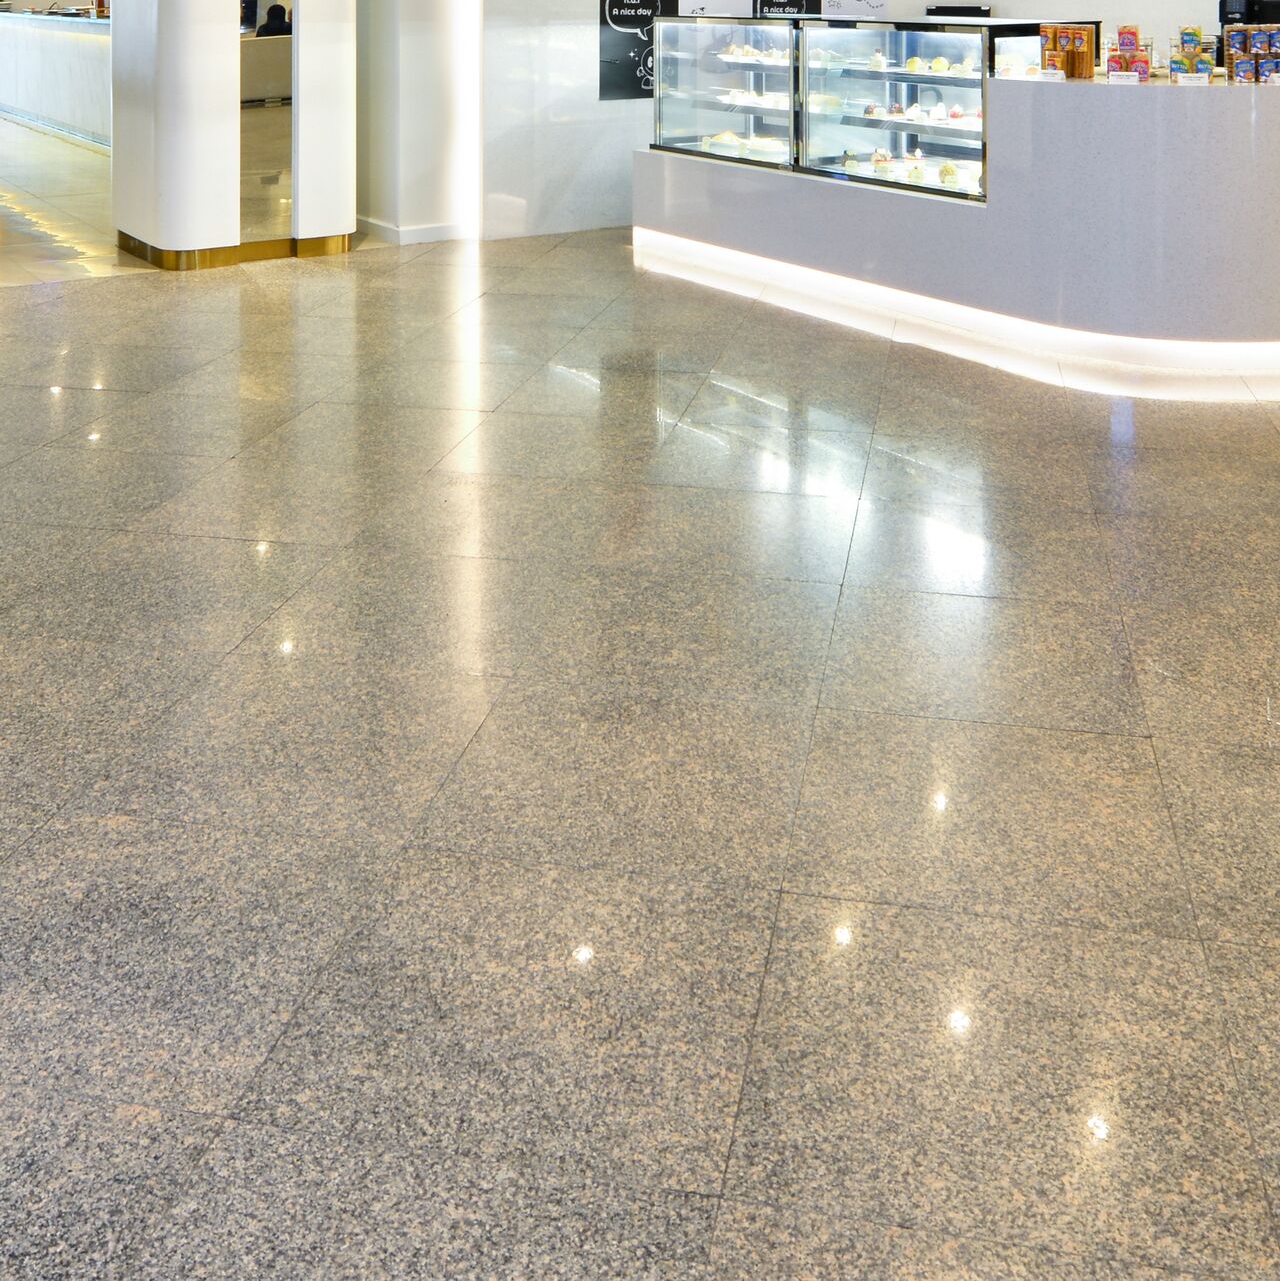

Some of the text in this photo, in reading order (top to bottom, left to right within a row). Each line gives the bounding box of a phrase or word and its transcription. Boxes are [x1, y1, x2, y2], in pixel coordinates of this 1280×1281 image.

[620, 7, 636, 16] nice
[636, 8, 652, 17] day
[770, 6, 784, 14] nice
[784, 7, 798, 15] day
